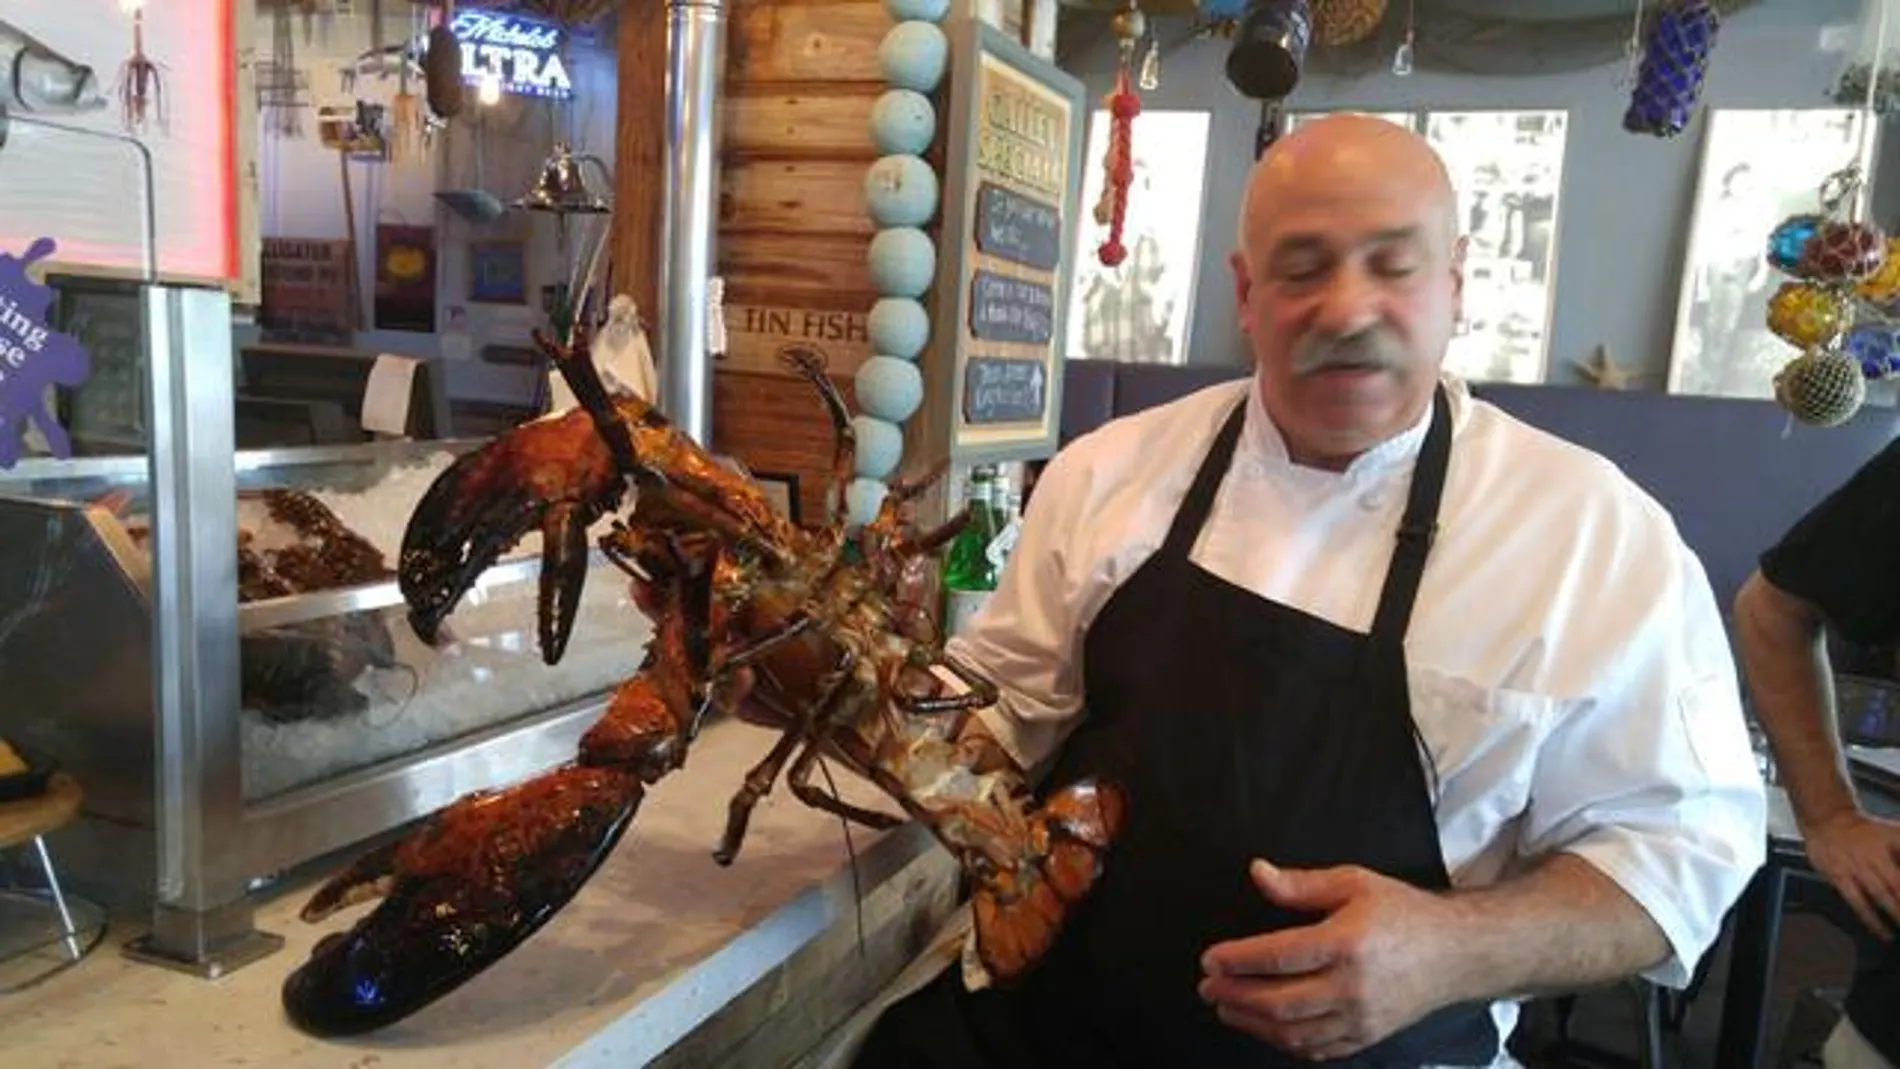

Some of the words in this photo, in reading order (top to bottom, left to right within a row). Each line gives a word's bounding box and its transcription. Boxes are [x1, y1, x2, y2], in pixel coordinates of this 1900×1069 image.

[459, 43, 571, 88] LTRA
[745, 308, 791, 336] TIN
[802, 311, 869, 343] FISH
